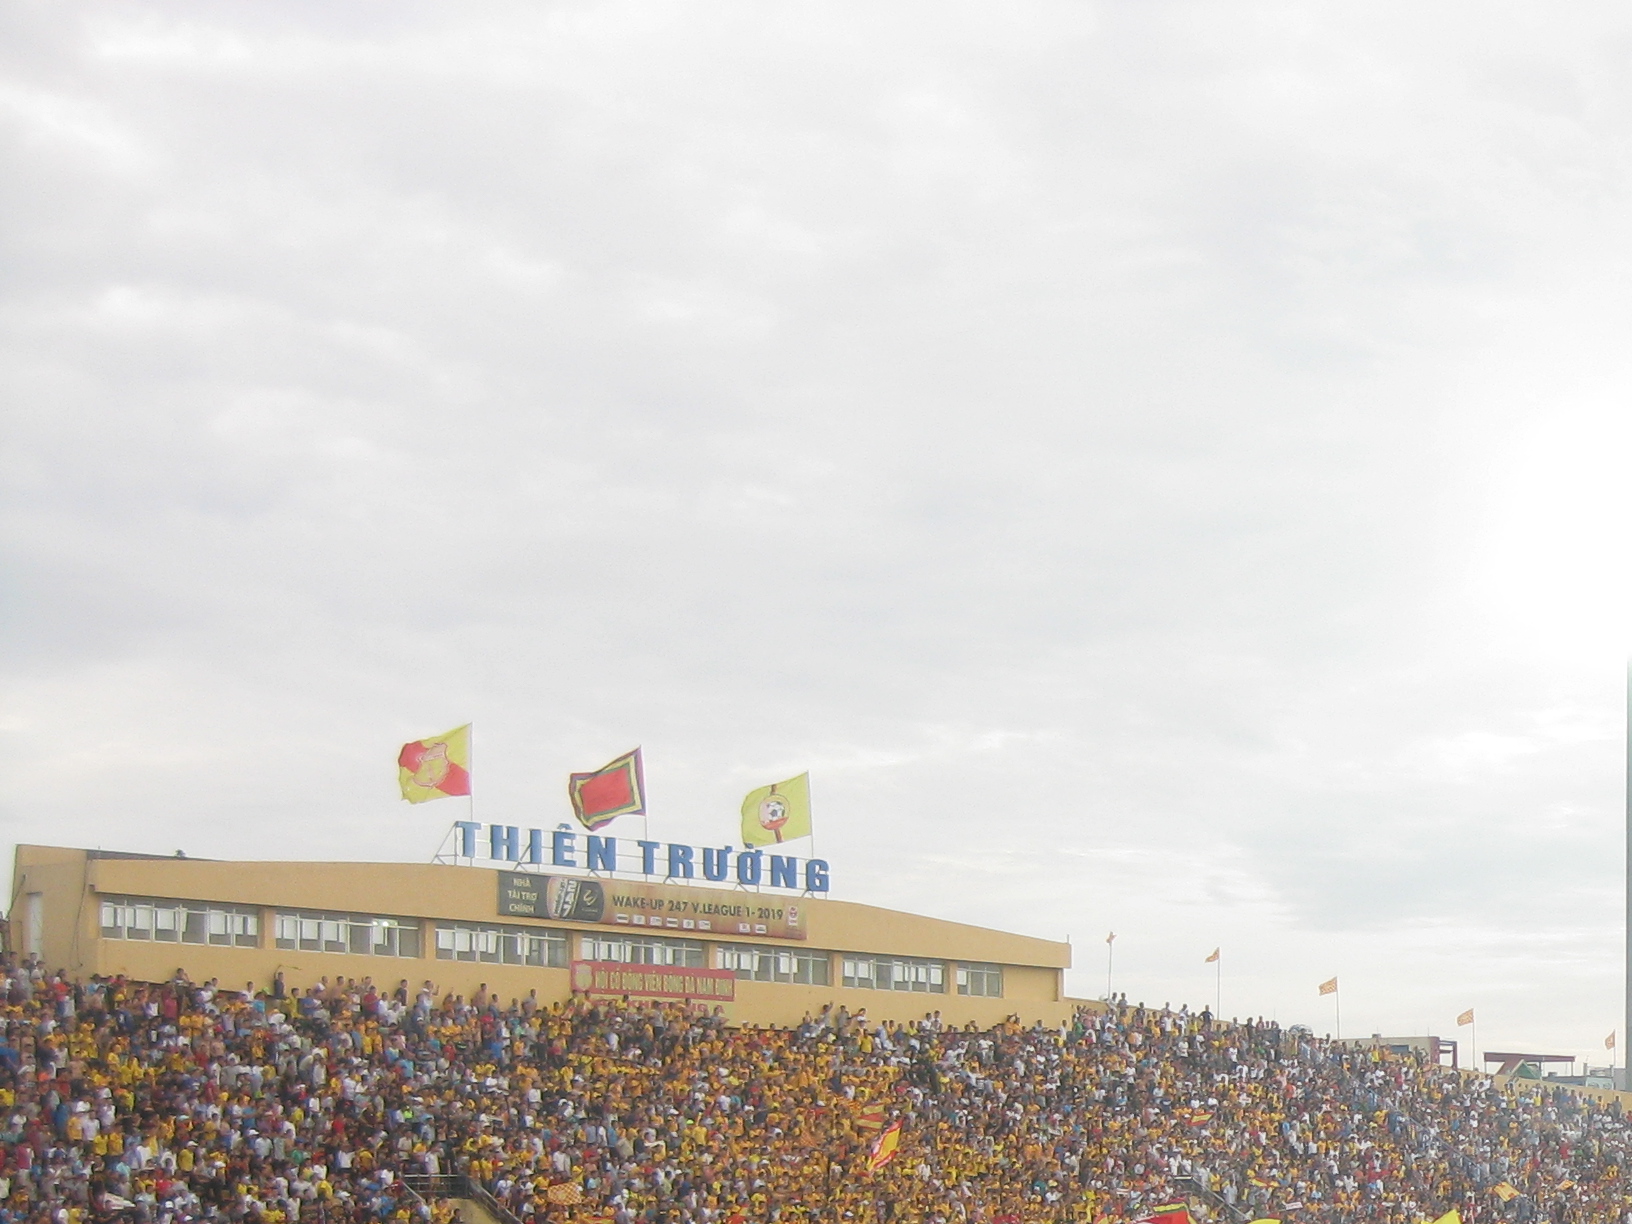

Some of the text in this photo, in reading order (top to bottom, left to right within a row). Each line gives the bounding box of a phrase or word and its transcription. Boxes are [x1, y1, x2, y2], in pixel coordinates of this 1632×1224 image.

[455, 821, 830, 892] THIÊN TRƯỜNG
[612, 895, 783, 920] WAKE-UP 247 V.LEAGUE 2019
